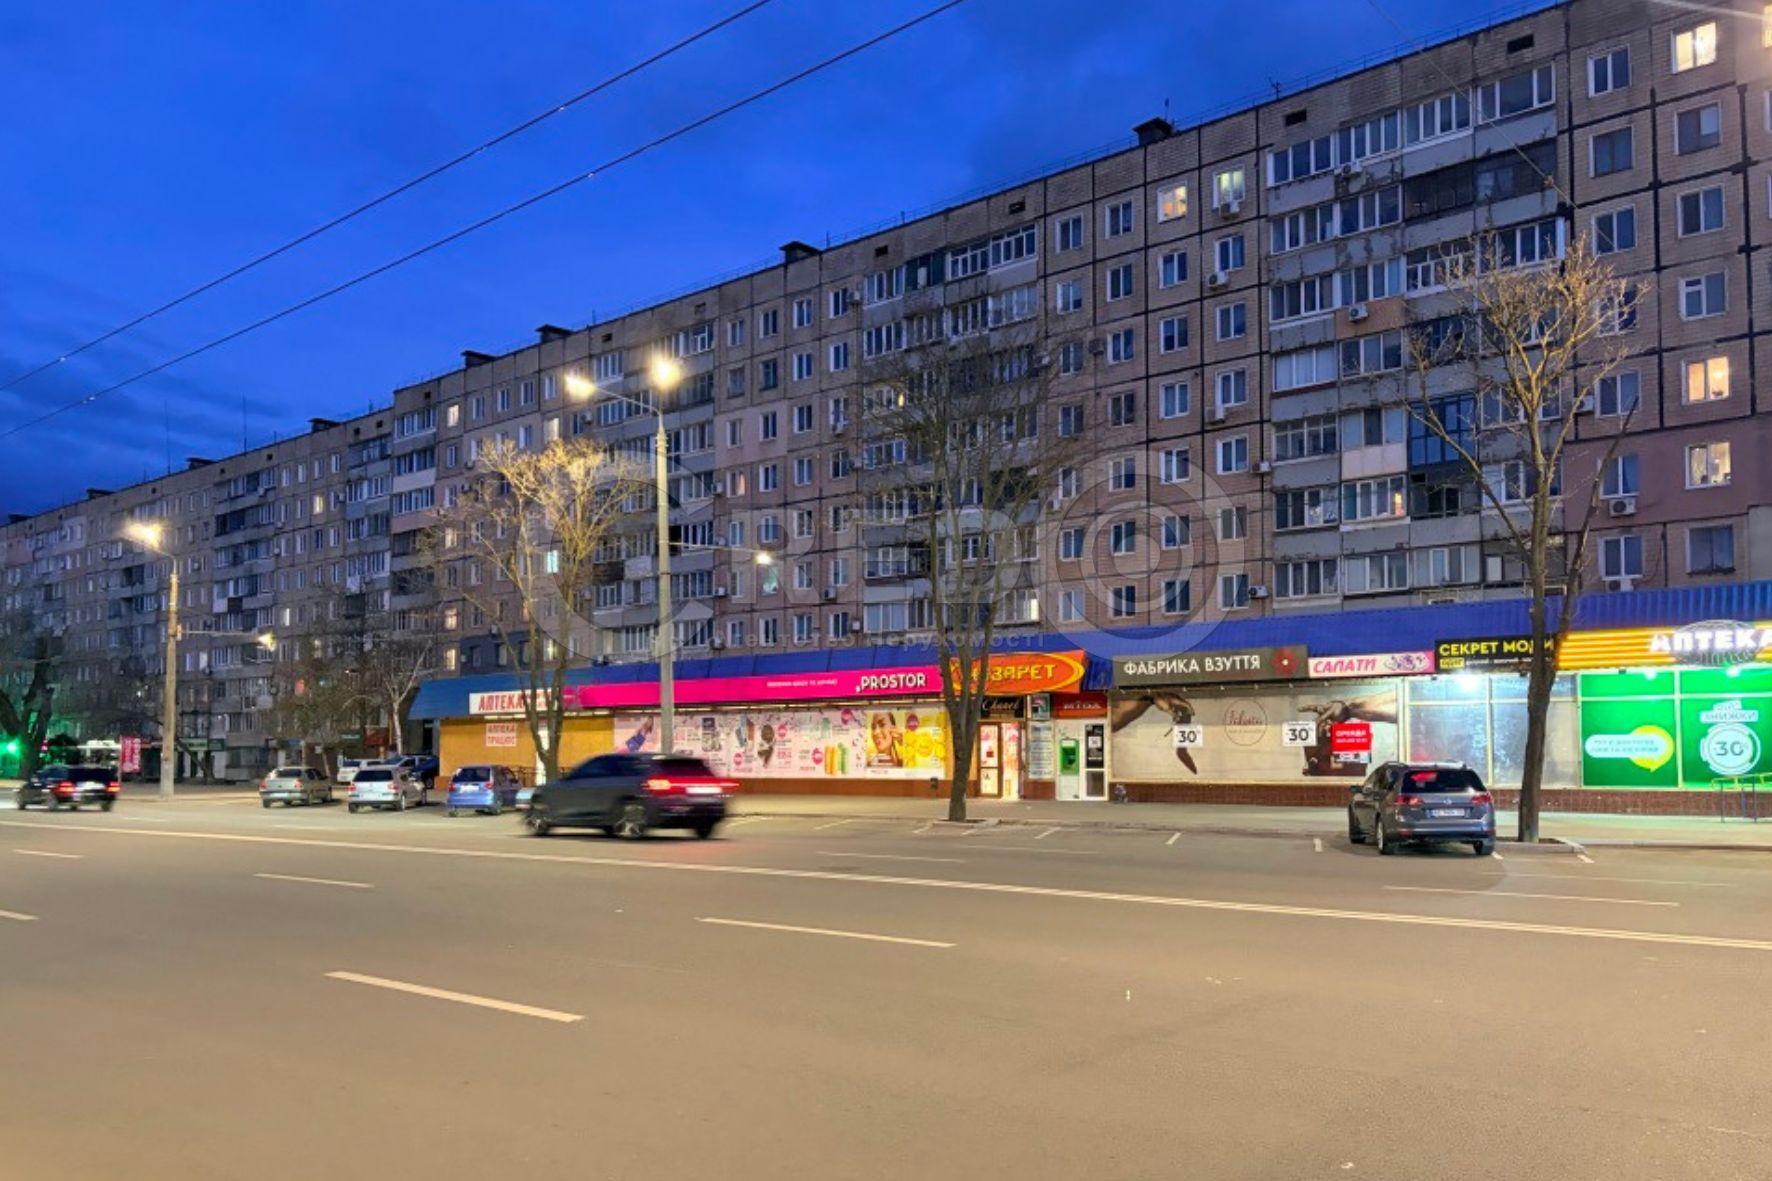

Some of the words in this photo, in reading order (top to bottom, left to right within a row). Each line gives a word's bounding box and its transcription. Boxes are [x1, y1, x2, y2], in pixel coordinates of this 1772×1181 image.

[1438, 641, 1499, 657] СЕКРЕТ
[1123, 658, 1201, 676] ФАБРИКА
[1204, 655, 1262, 673] ВЗУТТЯ
[1312, 658, 1378, 675] САЛАТИ
[860, 672, 926, 691] PROSTOR
